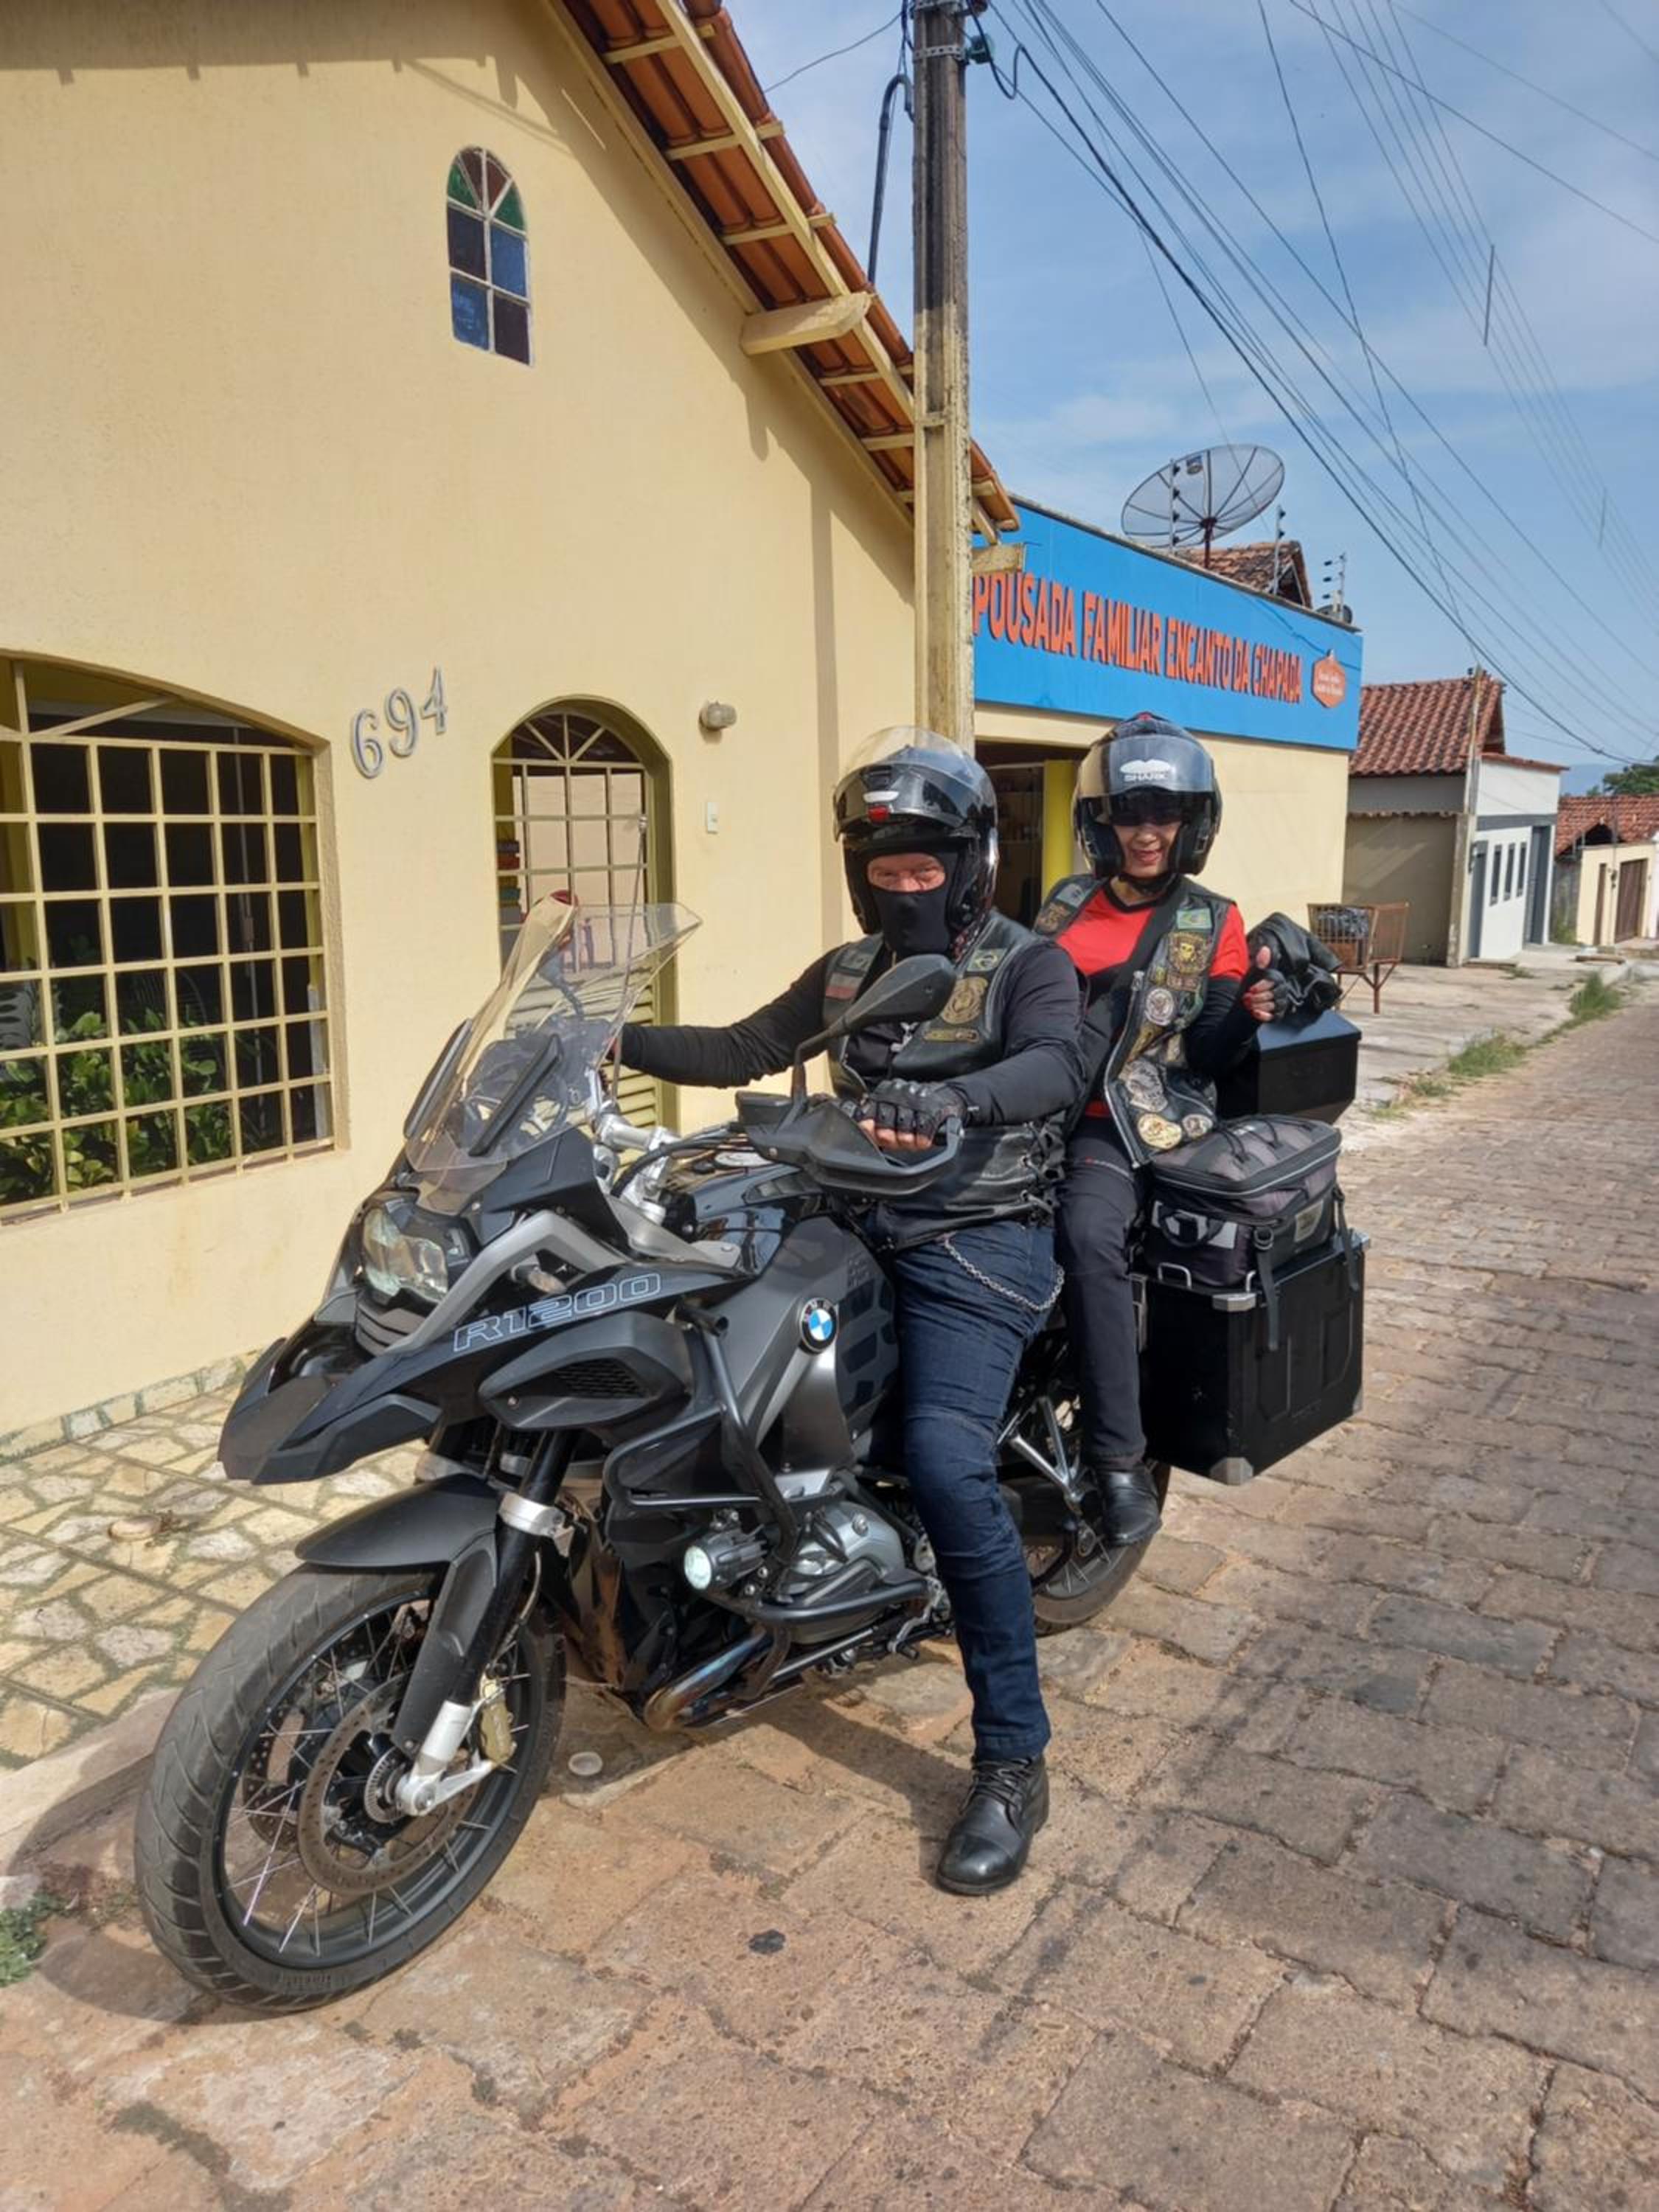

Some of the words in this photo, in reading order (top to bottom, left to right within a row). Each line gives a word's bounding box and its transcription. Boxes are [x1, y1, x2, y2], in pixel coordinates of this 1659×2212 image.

[973, 571, 1077, 658] POUSADA
[1082, 591, 1162, 676] FAMILIAR
[1164, 617, 1231, 691] ENCANTO
[1231, 636, 1250, 695] DA
[1251, 642, 1303, 704] CHAPADA
[351, 667, 448, 779] 694
[453, 1273, 661, 1352] R1200
